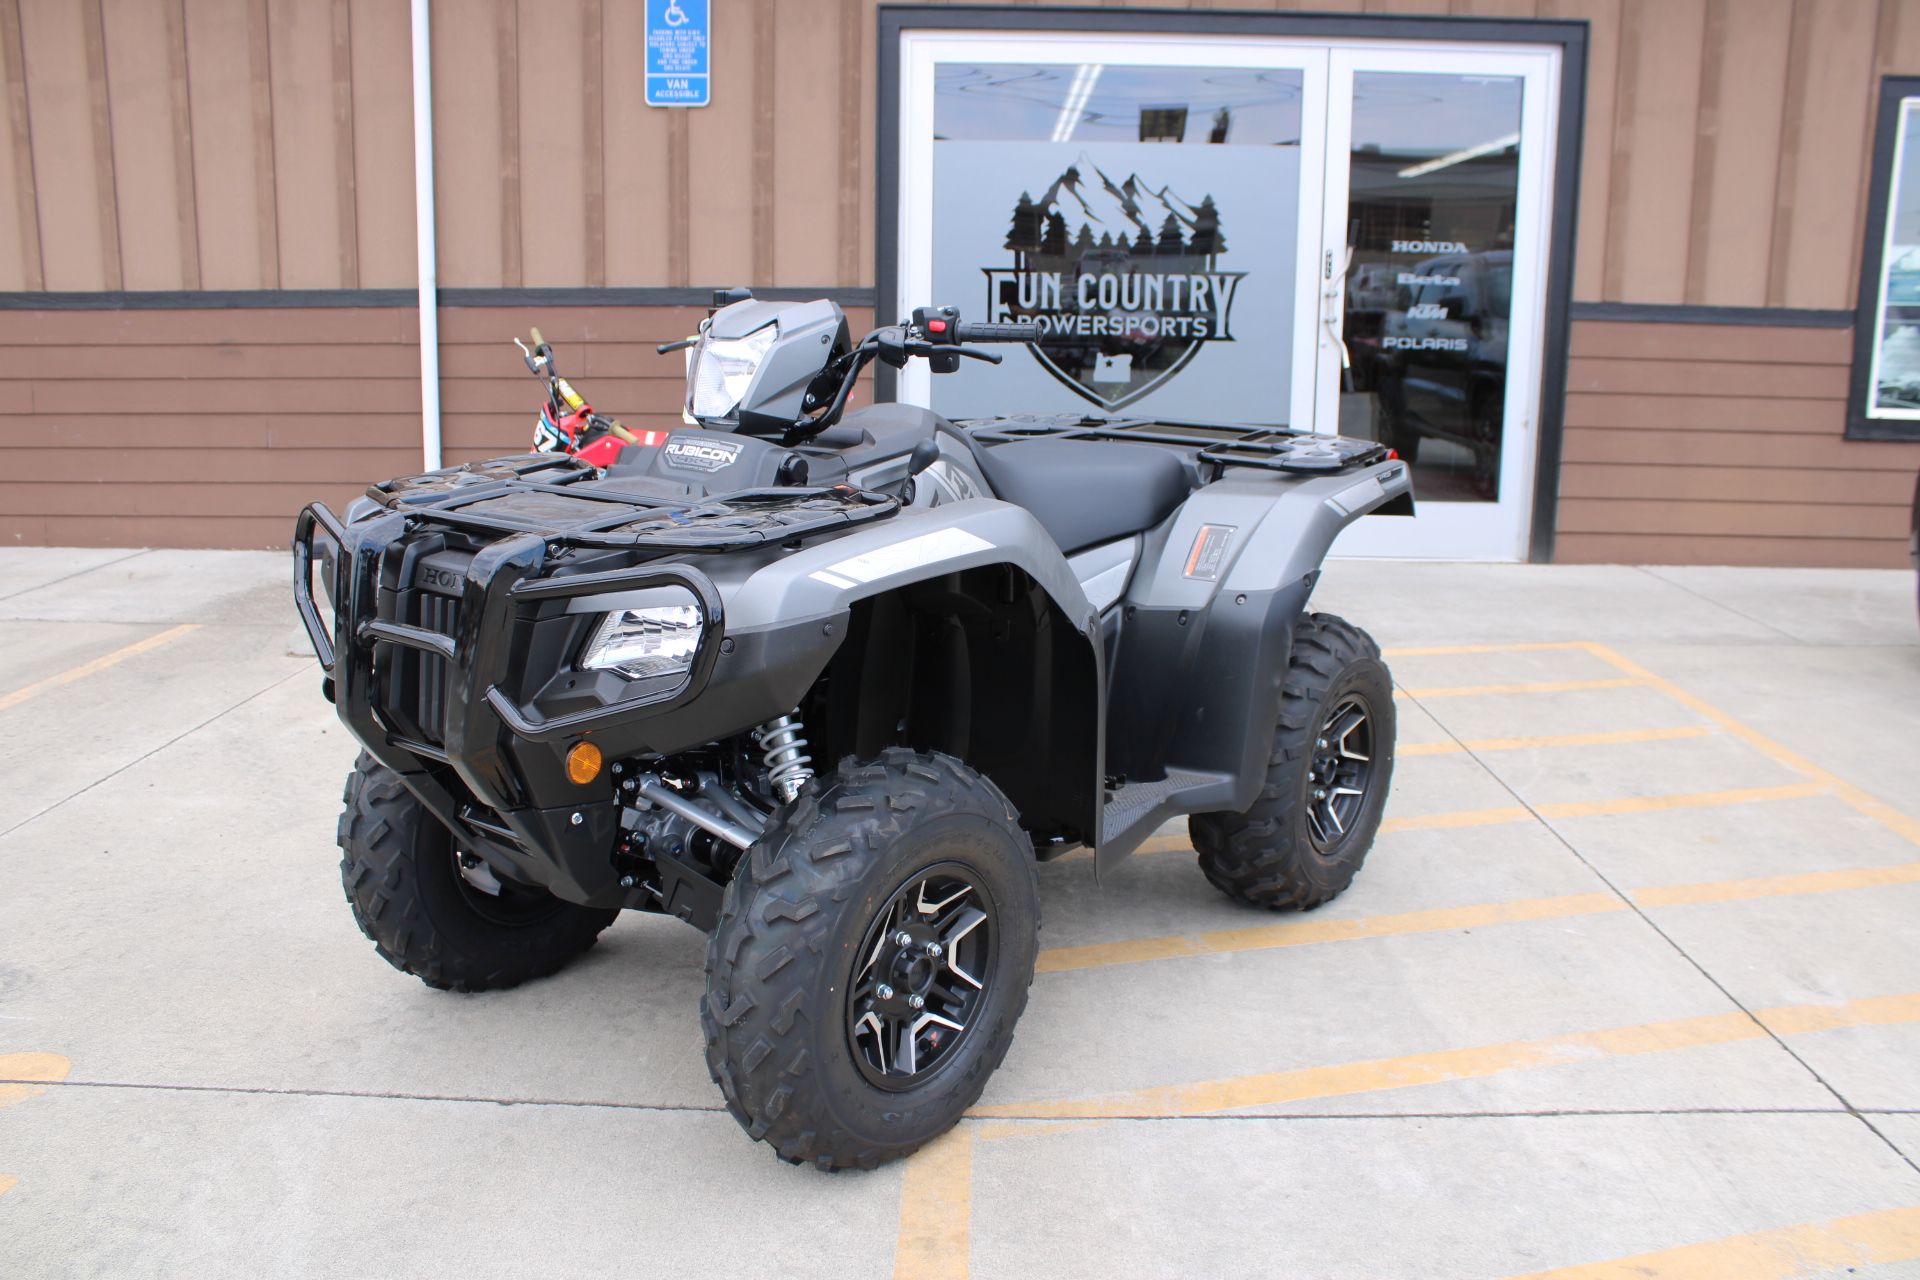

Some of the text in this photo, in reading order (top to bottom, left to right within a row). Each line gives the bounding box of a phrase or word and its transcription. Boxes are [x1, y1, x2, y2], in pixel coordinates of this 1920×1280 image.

[667, 79, 688, 89] VAN
[655, 89, 699, 98] ACCESSIBLE
[1392, 240, 1468, 254] HONDA
[1398, 273, 1460, 287] Beta
[990, 271, 1237, 338] FUN COUNTRY
[1407, 304, 1449, 320] KTM
[1017, 314, 1208, 338] POWERSPORTS
[1383, 337, 1468, 351] POLARIS
[665, 444, 738, 463] RUBICON
[423, 567, 466, 589] HON
